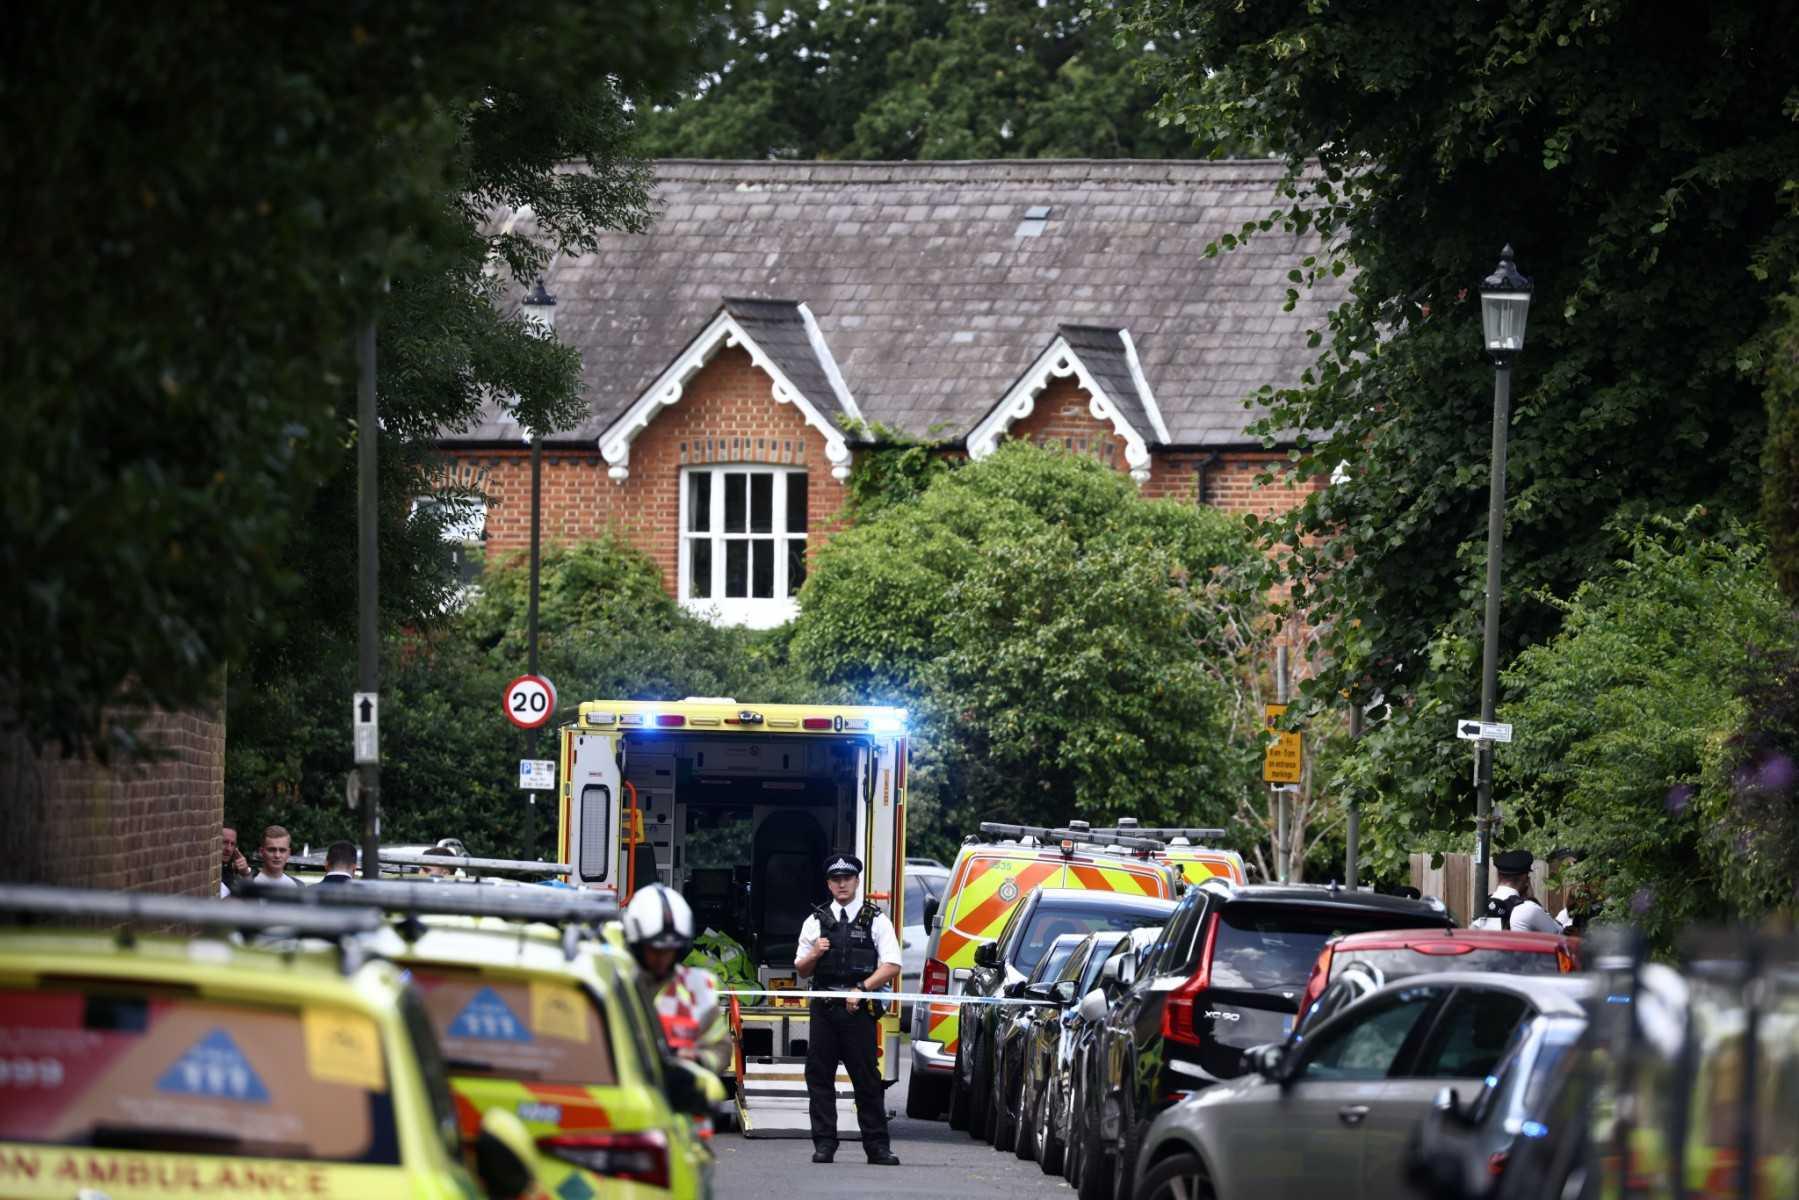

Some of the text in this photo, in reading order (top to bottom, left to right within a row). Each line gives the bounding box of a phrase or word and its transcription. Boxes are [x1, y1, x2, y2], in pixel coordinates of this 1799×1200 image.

[513, 692, 546, 712] 20
[0, 1153, 329, 1192] N AMBULANCE
